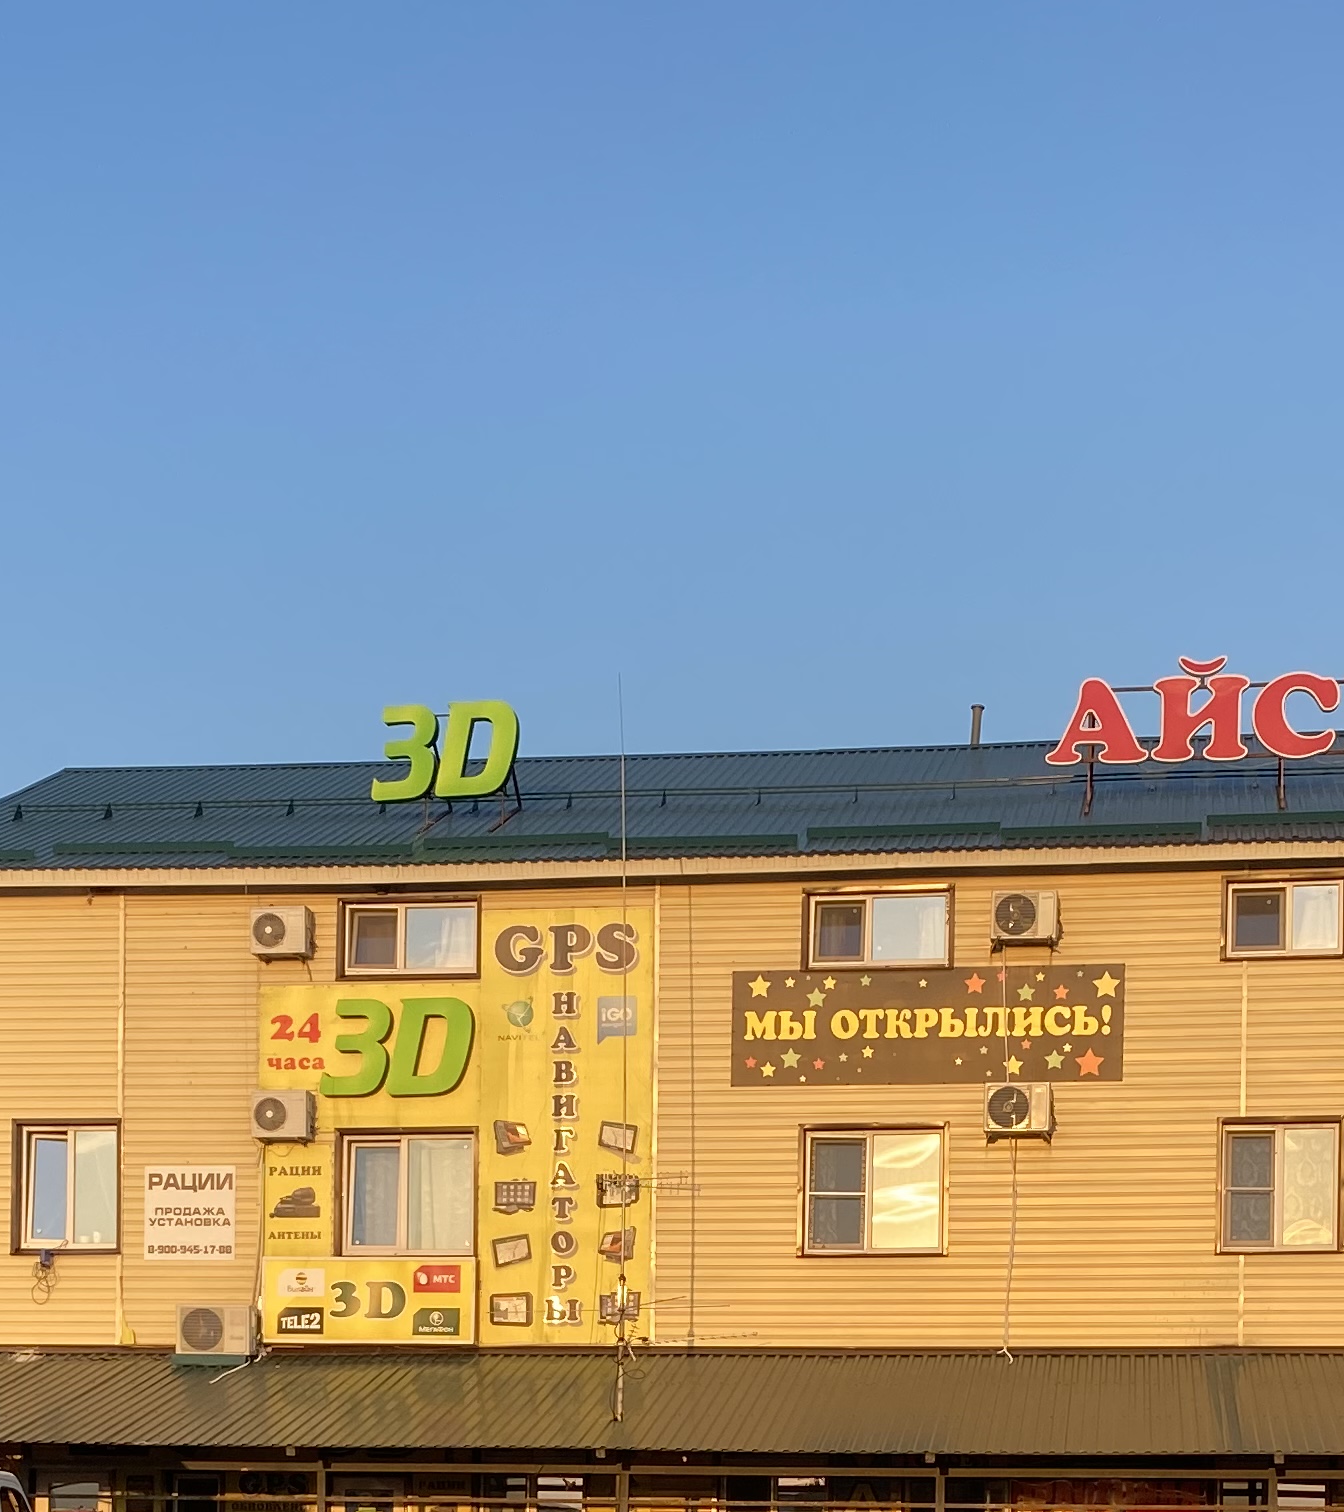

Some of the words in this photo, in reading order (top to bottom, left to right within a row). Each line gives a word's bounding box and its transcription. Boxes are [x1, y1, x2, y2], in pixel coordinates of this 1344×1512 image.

[494, 922, 639, 977] GPS
[269, 1013, 323, 1044] 24
[743, 1007, 818, 1042] МЫ
[830, 1002, 1113, 1040] ОТКРЫЛИСЬ!
[320, 996, 477, 1098] 3D
[267, 1053, 325, 1071] часа
[542, 991, 582, 1327] НАВИГАТОРЫ
[268, 1165, 322, 1177] РАЦИИ
[148, 1173, 233, 1193] РАЦИИ
[154, 1207, 226, 1216] ПРОДАЖА
[149, 1218, 231, 1227] УСТАНОВКА
[268, 1231, 322, 1240] АНТЕНЫ
[432, 1274, 456, 1284] МТС
[329, 1281, 406, 1319] 3D
[280, 1312, 321, 1330] TELE2
